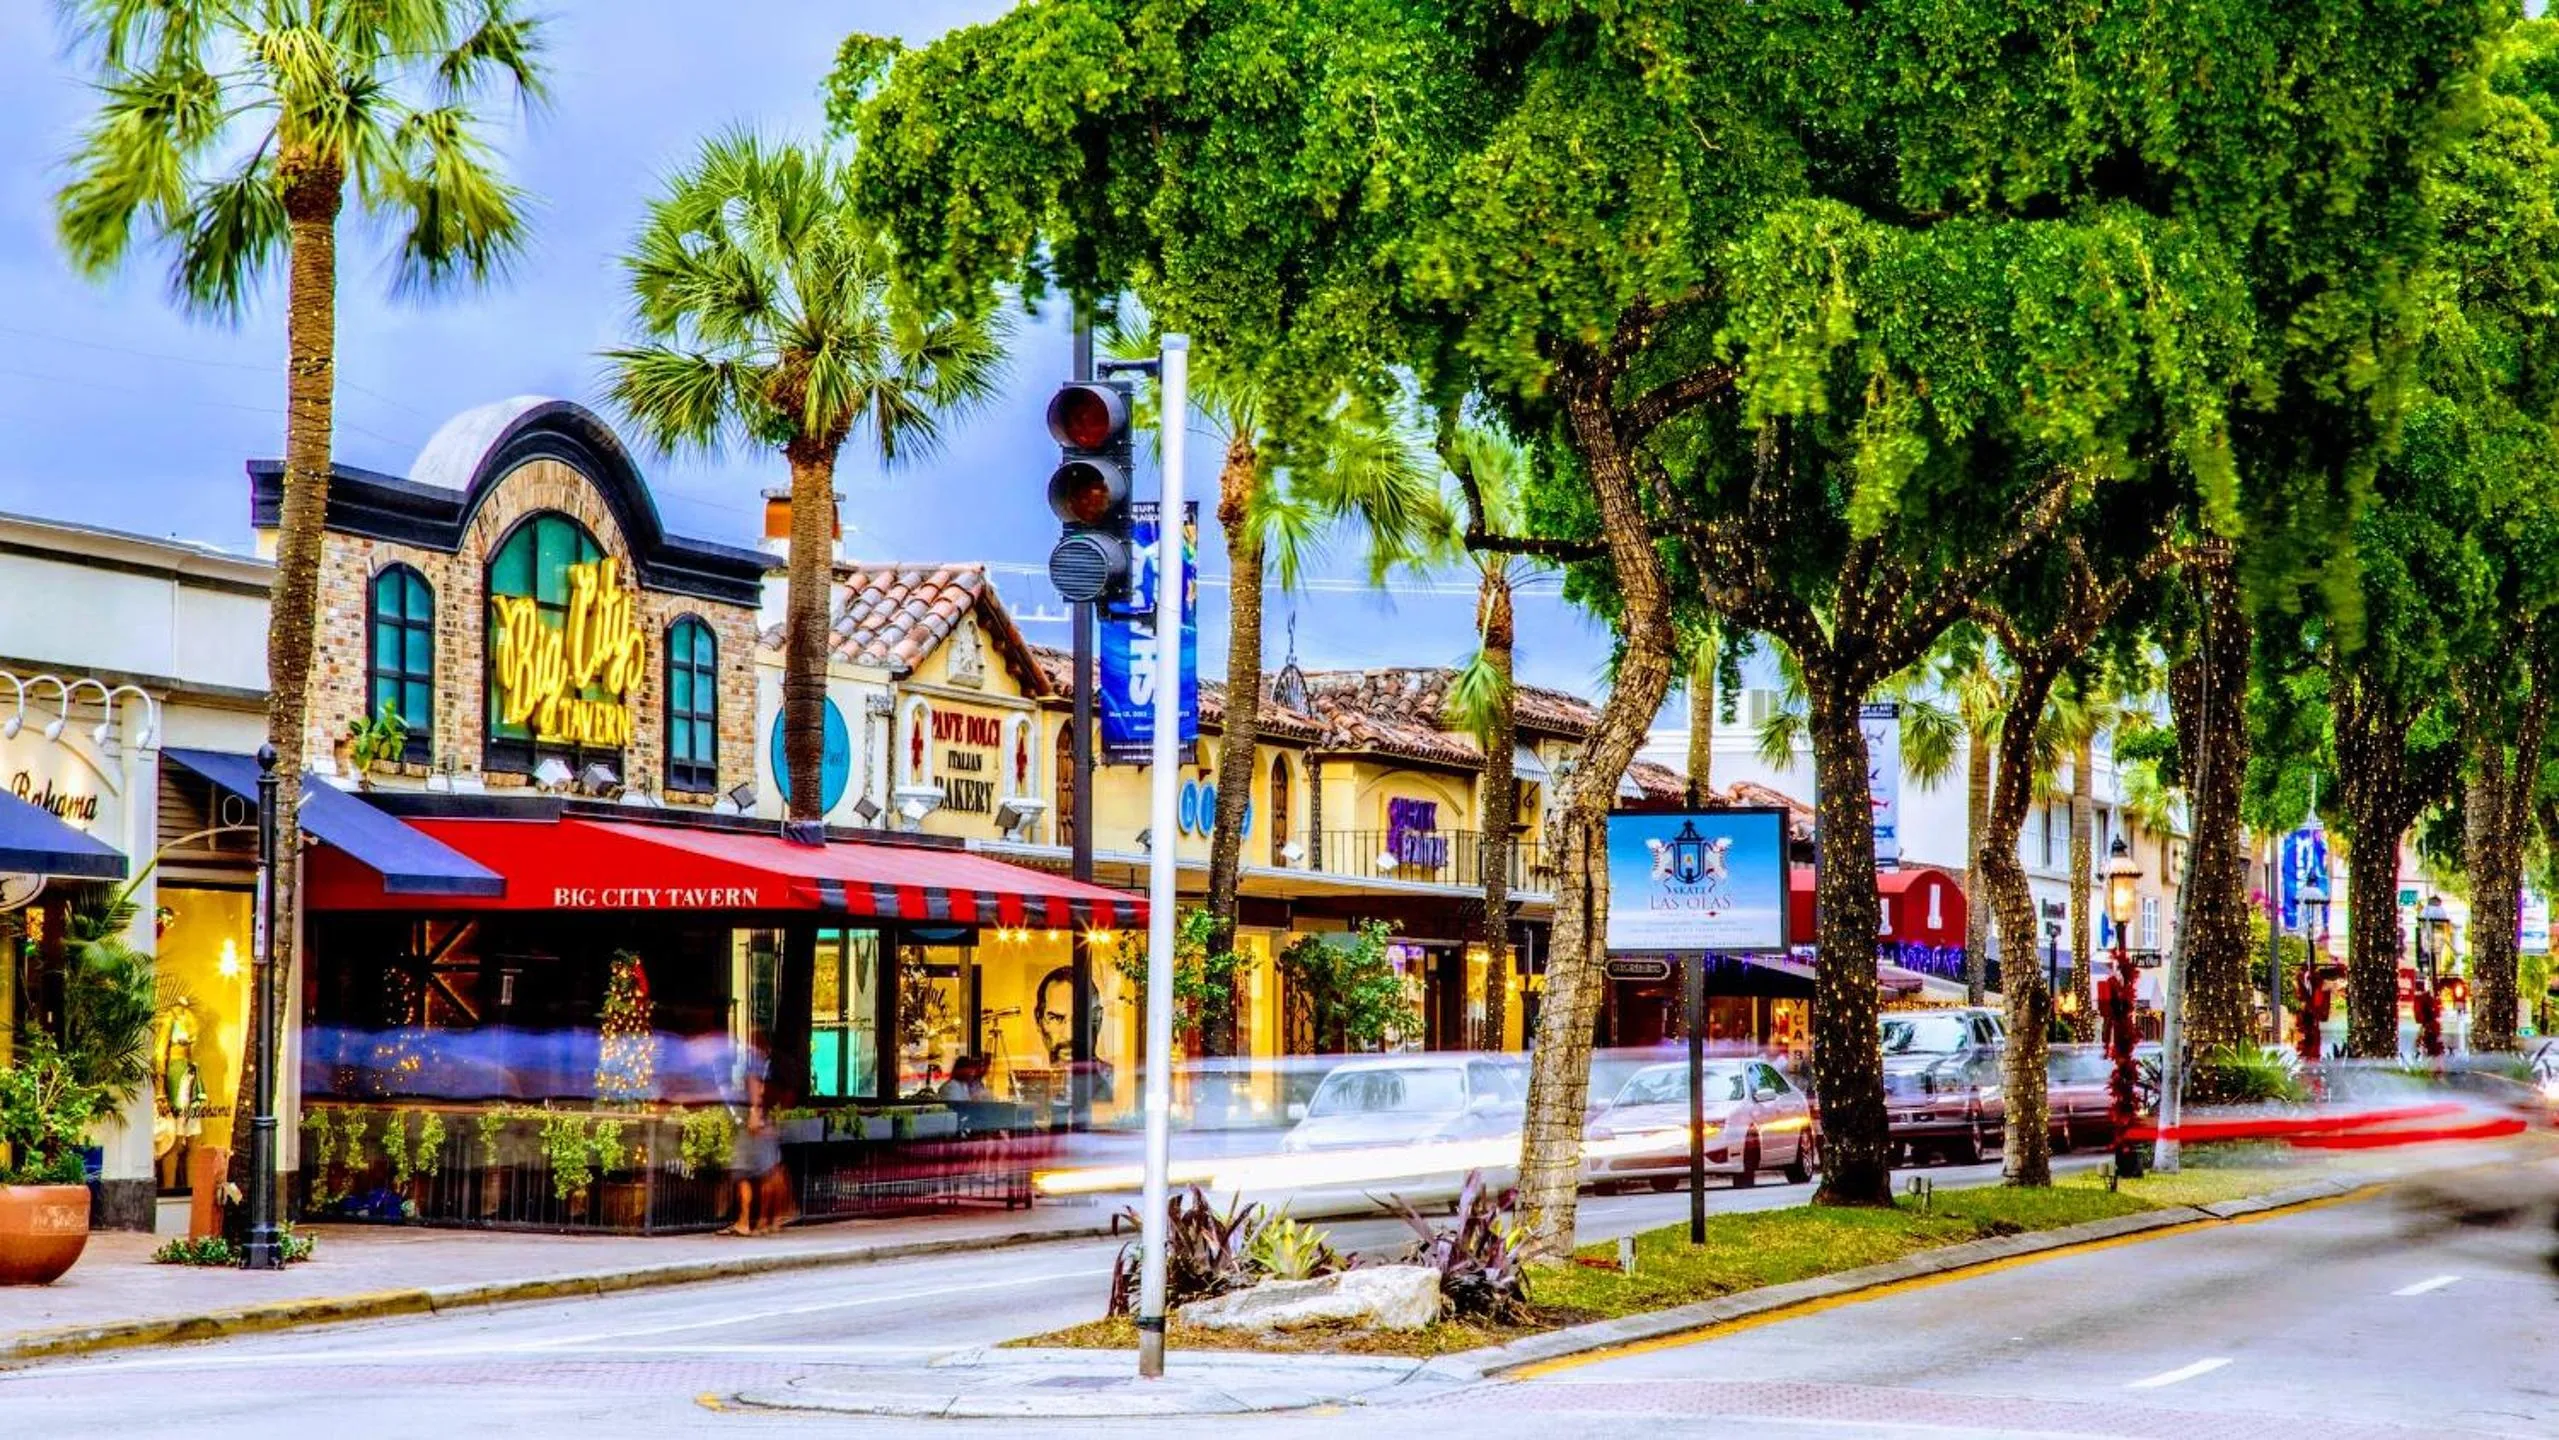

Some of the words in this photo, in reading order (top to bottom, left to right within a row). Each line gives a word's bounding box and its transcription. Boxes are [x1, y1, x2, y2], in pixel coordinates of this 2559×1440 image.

[491, 595, 568, 736] Big
[568, 556, 645, 695] City
[555, 697, 634, 746] TAVERN
[966, 714, 1001, 749] DOLCI
[947, 750, 983, 772] ITALIAN
[553, 887, 596, 907] BIG
[602, 887, 661, 907] CITY
[665, 887, 758, 907] TAVERN
[1650, 896, 1680, 910] LAS
[1686, 896, 1732, 910] OLAS
